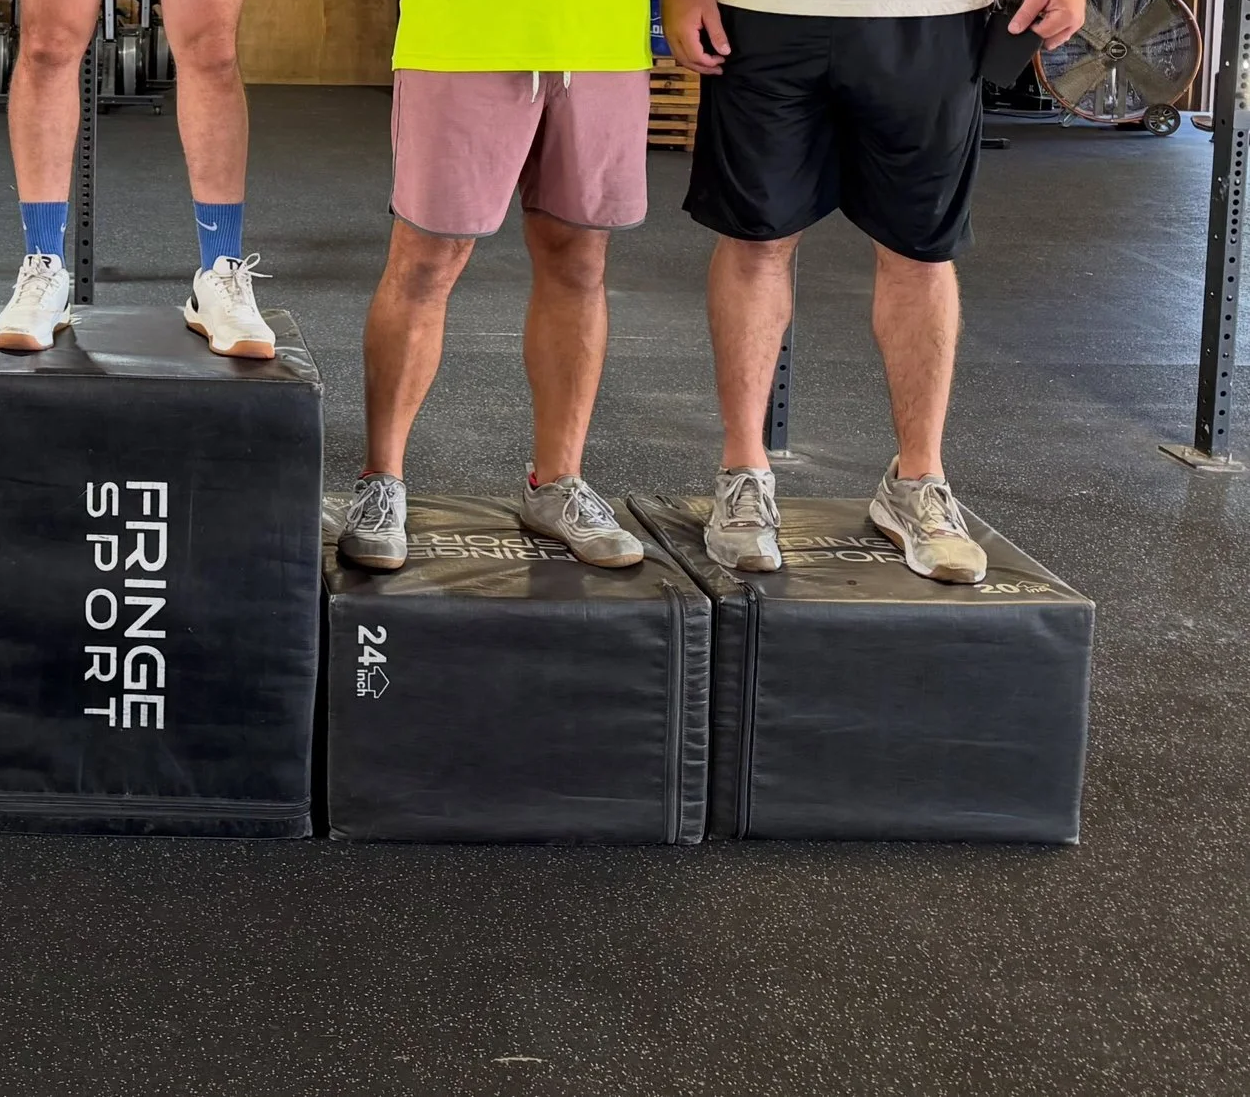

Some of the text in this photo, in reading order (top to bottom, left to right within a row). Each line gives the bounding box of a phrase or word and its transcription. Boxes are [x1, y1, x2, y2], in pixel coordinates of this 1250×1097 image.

[226, 258, 243, 270] TY
[83, 481, 119, 729] SPORT
[121, 480, 168, 730] FRINGE
[973, 583, 1020, 594] 20
[354, 624, 388, 698] 24 inch
